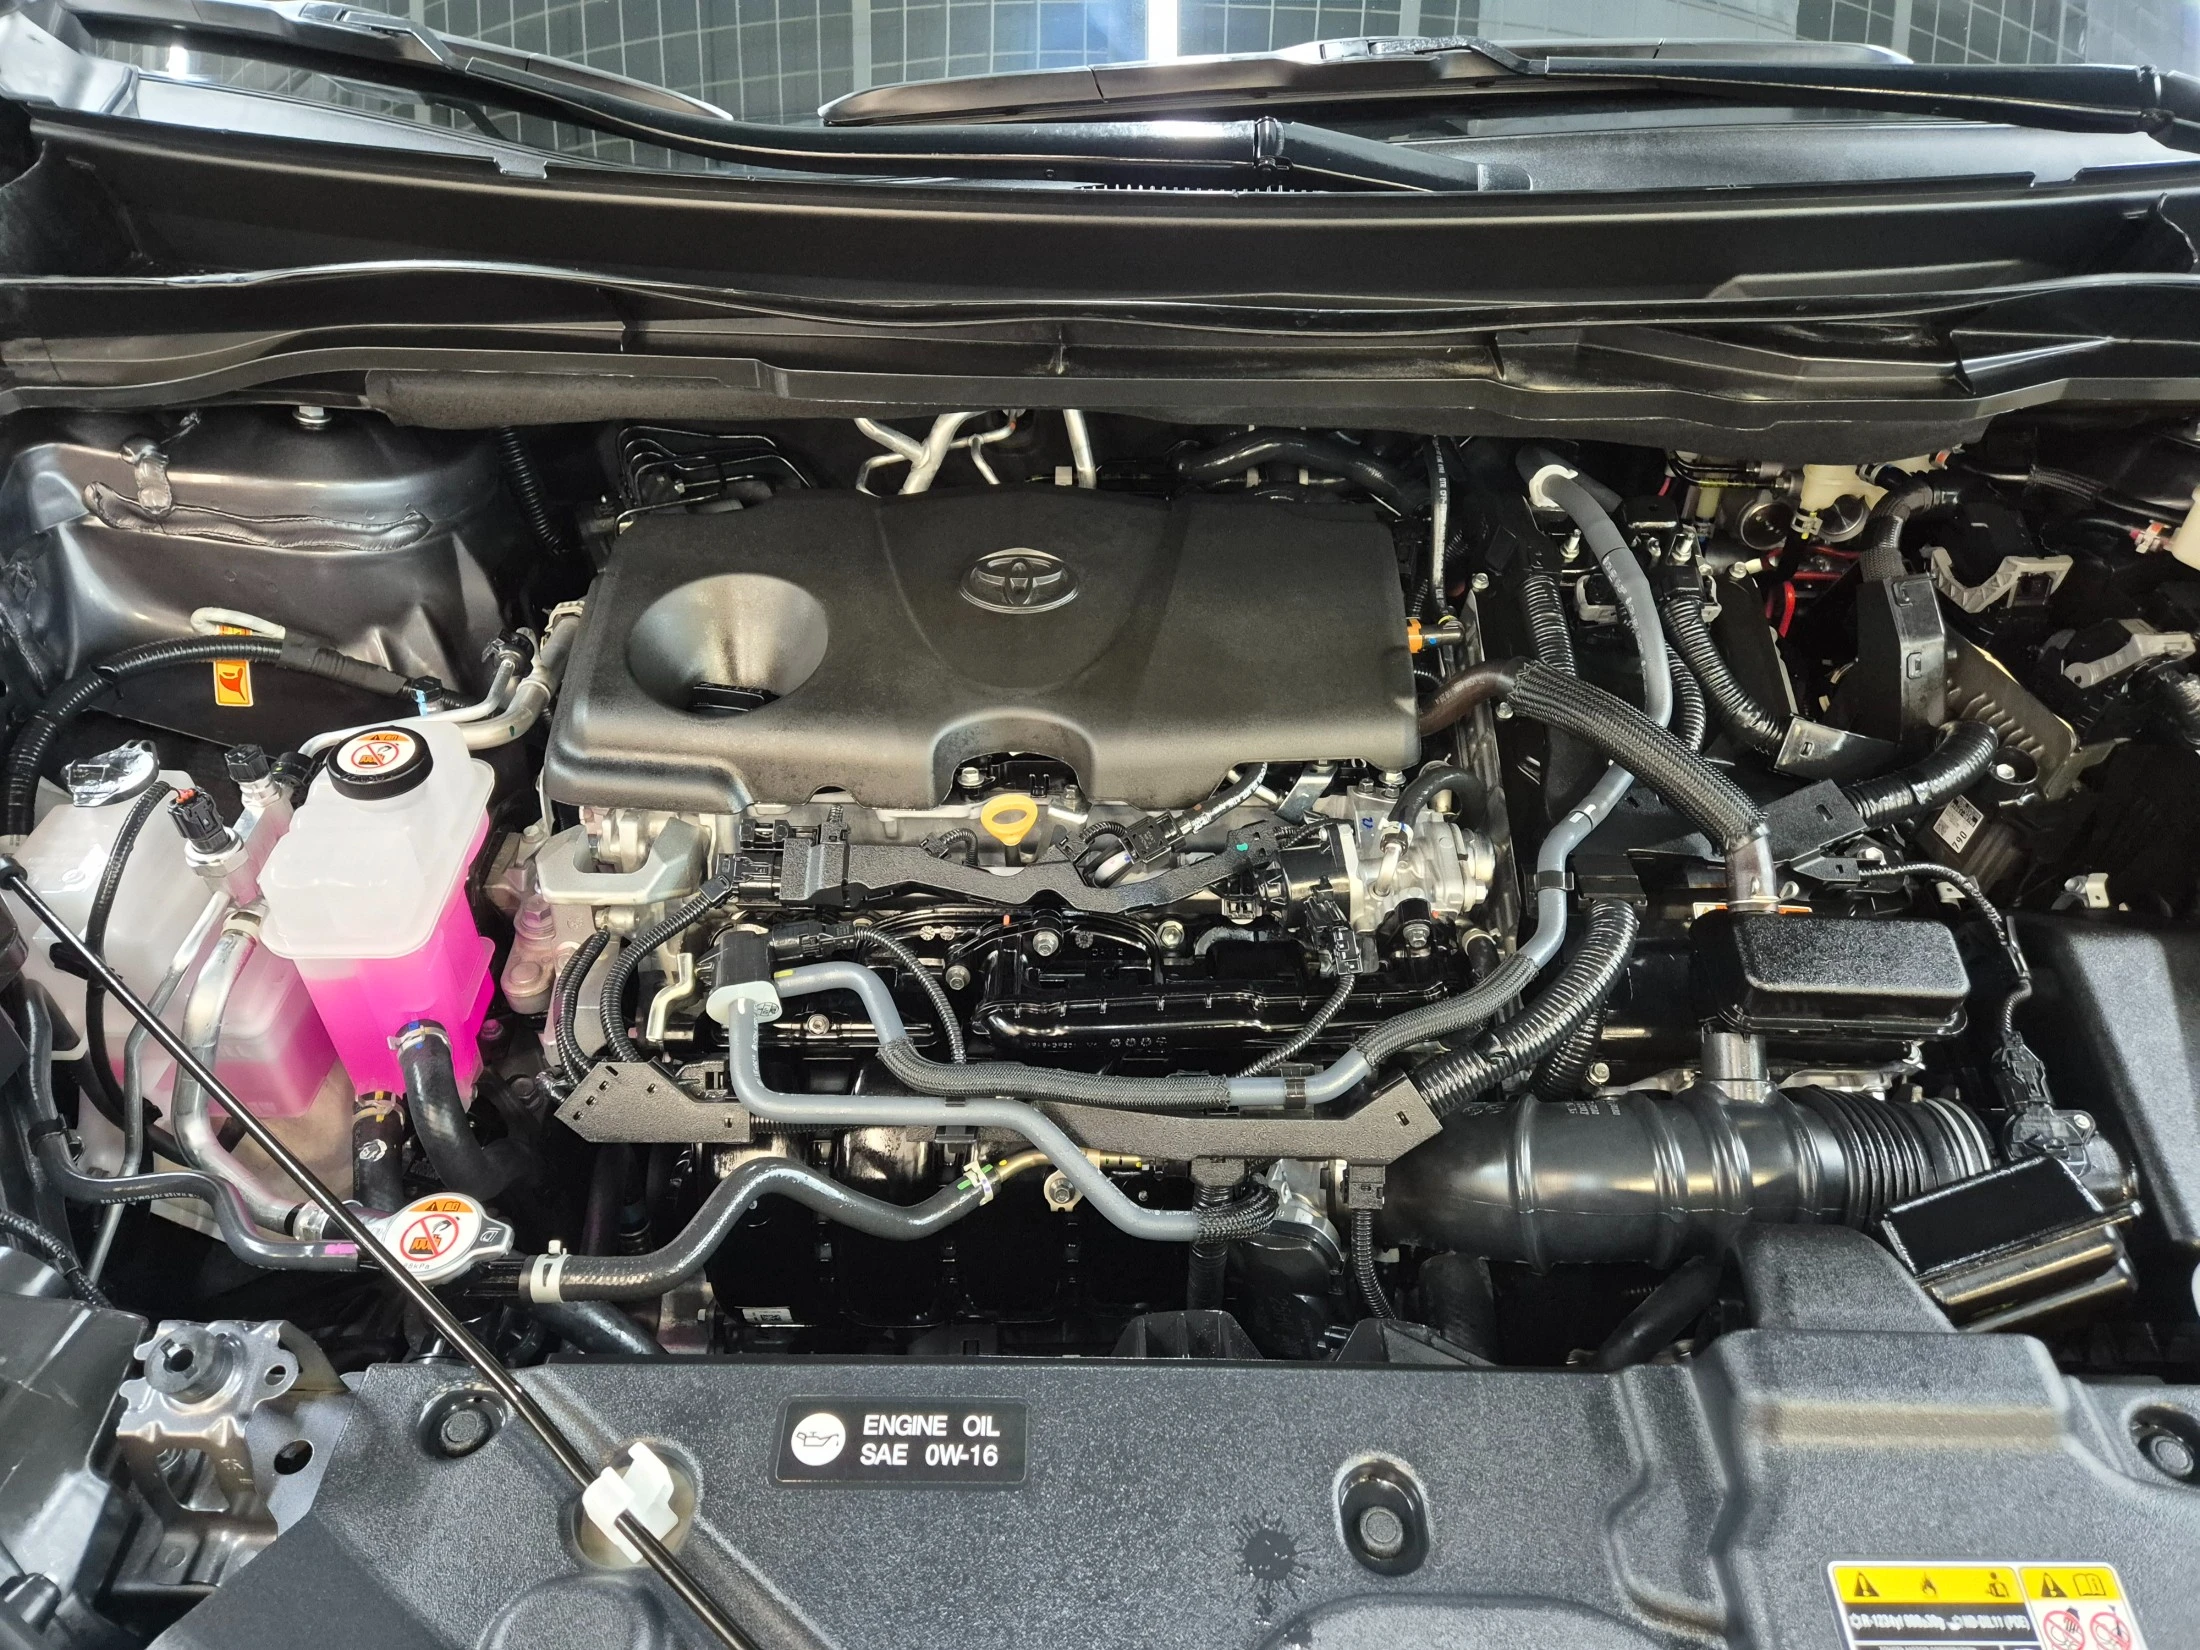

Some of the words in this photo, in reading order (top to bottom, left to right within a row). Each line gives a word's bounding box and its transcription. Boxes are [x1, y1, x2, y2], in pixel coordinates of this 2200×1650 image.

[1951, 830, 1967, 850] 790
[863, 1414, 948, 1437] ENGINE
[963, 1415, 1001, 1437] OIL
[860, 1443, 908, 1466] SAE
[925, 1444, 998, 1467] 0W-16
